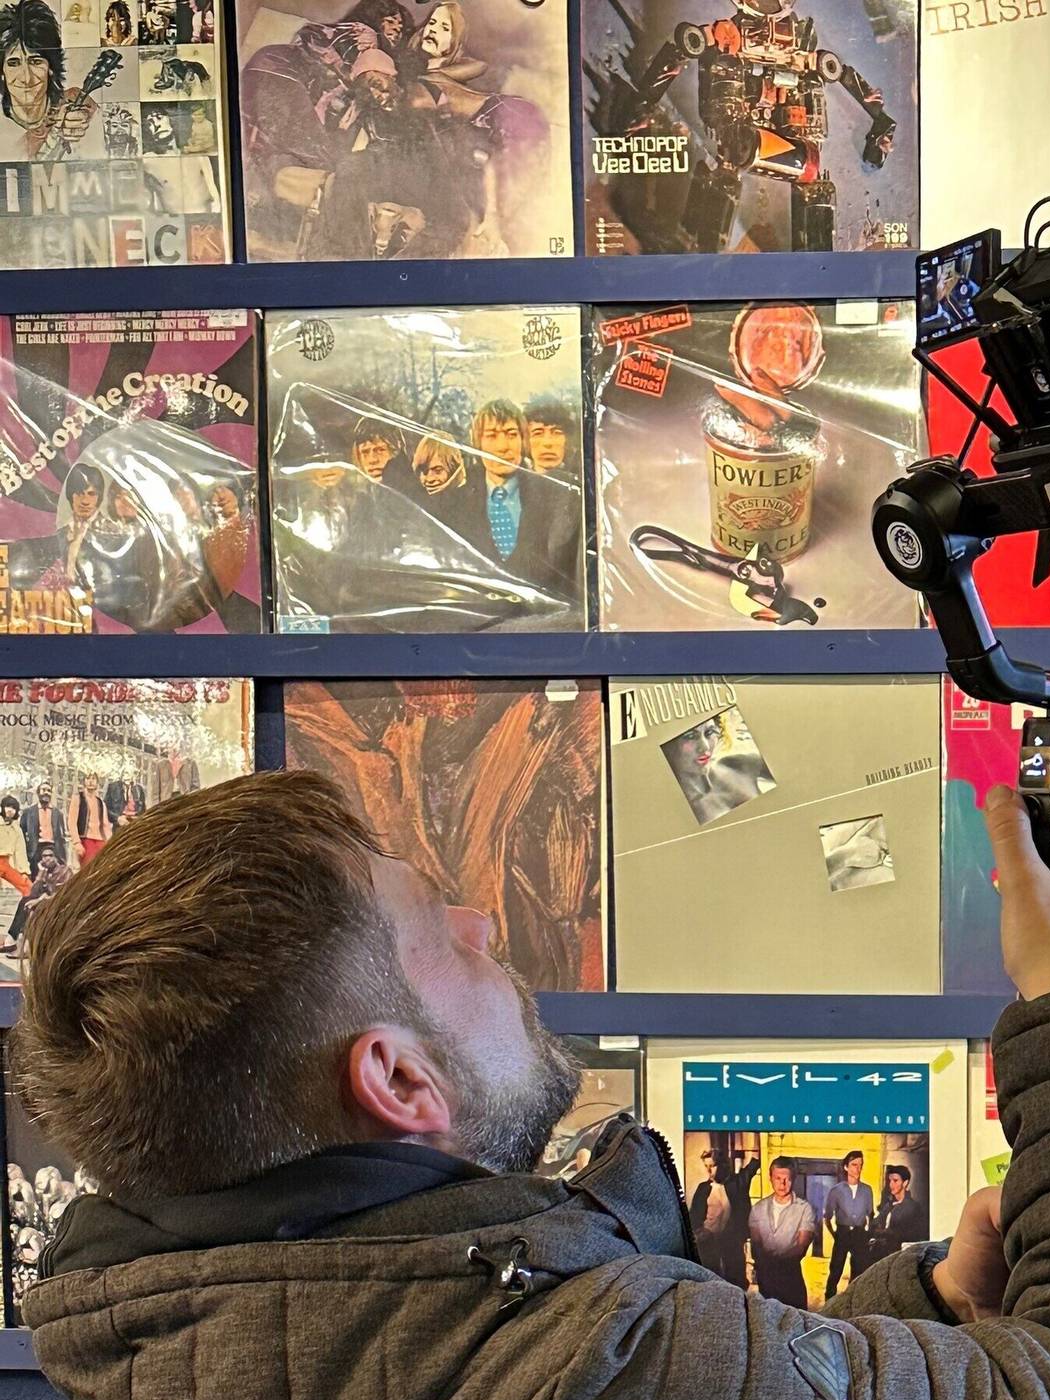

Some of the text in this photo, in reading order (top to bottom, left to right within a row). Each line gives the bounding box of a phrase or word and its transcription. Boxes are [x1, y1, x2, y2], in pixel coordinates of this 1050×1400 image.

[592, 136, 688, 153] TECHNOPOP
[884, 222, 908, 233] SON
[73, 218, 225, 265] NECK
[642, 313, 687, 331] Fingers
[624, 357, 664, 381] Rolling
[621, 370, 660, 391] Stones
[0, 440, 57, 496] Best
[123, 372, 250, 417] Creation
[733, 500, 759, 512] WEST
[716, 523, 808, 553] TREACLE
[0, 713, 135, 728] ROCK MUSIC FROM
[685, 1064, 923, 1089] LEVEL 42
